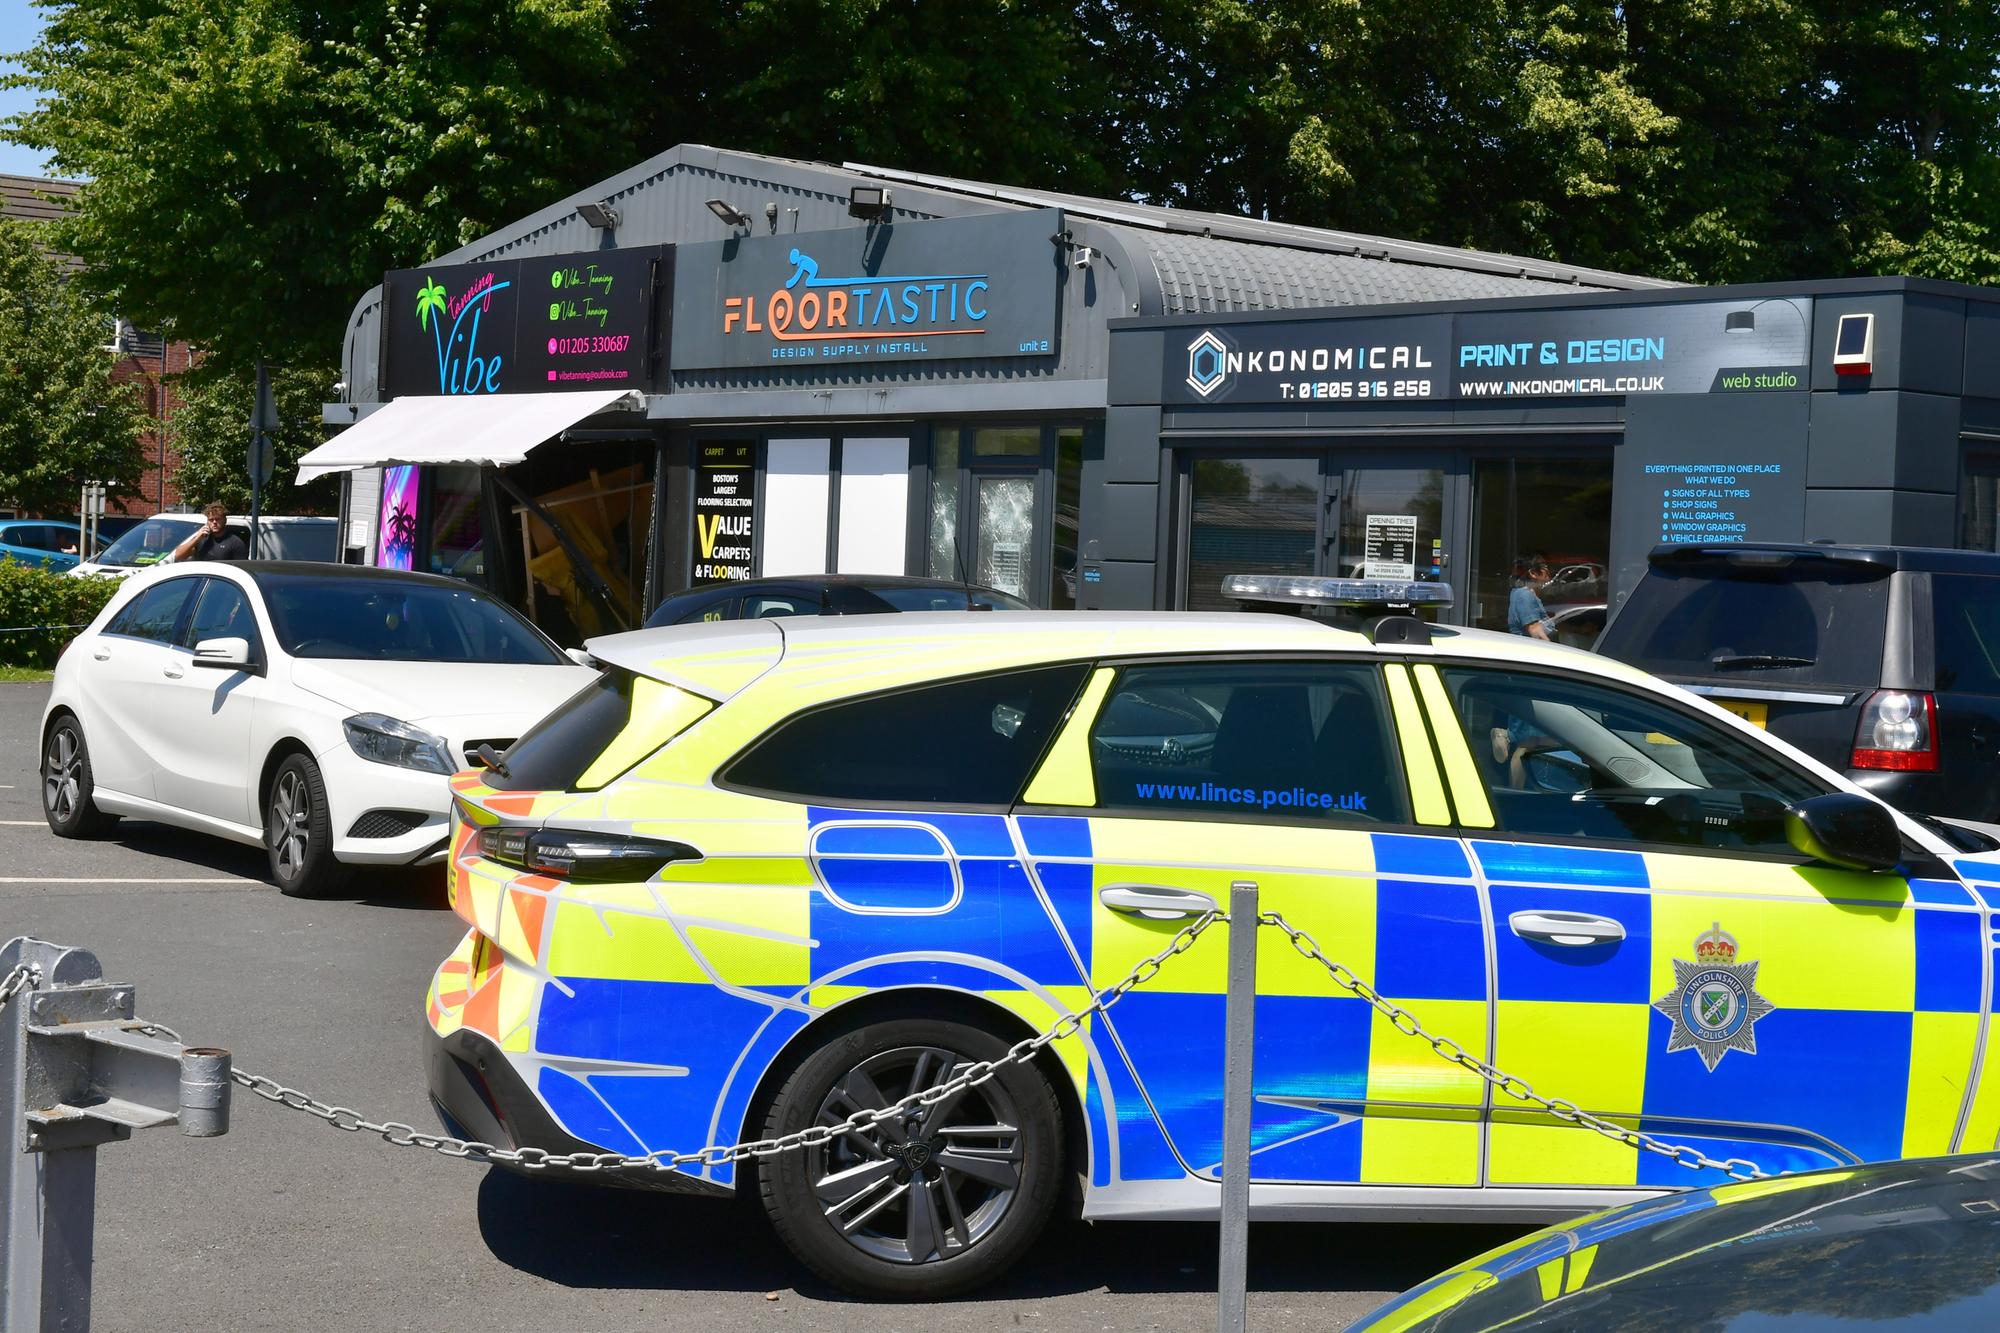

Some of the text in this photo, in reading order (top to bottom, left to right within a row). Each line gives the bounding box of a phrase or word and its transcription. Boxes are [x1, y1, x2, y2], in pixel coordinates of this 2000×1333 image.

[447, 272, 494, 320] tanning
[724, 281, 988, 339] FLOORTASTIC
[430, 281, 509, 394] Vibe
[559, 335, 630, 354] 01205 330687
[772, 342, 928, 358] DESIGN SUPPLY INSTALL
[1020, 340, 1048, 352] unit 2
[1460, 337, 1664, 368] PRINT & DESIGN
[1217, 346, 1432, 373] INKONOMICAL
[1460, 377, 1664, 396] WWW.INKONOMICAL.CO.UK
[1722, 371, 1797, 388] web studio
[1280, 380, 1431, 398] T: 01205 316 258
[705, 448, 724, 456] CARPET
[1645, 464, 1781, 473] EVERYTHING PRINTED IN ONE PLACE
[712, 474, 739, 483] BOSTON'S
[1685, 476, 1736, 484] WHAT WE DO
[713, 486, 737, 495] LARGEST
[1672, 490, 1750, 498] SIGNS OF ALL TYPES
[697, 498, 752, 507] FLOORING SELECTION
[1671, 501, 1717, 509] SHOP SIGNS
[1671, 512, 1735, 520] WALL GRAPHICS
[1671, 523, 1746, 532] WINDOW GRAPHICS
[697, 514, 751, 559] VALUE
[1670, 534, 1702, 543] VEHICLE
[712, 546, 751, 560] CARPETS
[695, 564, 750, 580] & FLOORING
[1136, 783, 1368, 810] www.lincs.police.uk
[1687, 973, 1744, 996] LINCOLNSHIRE
[1697, 1028, 1729, 1039] POLICE
